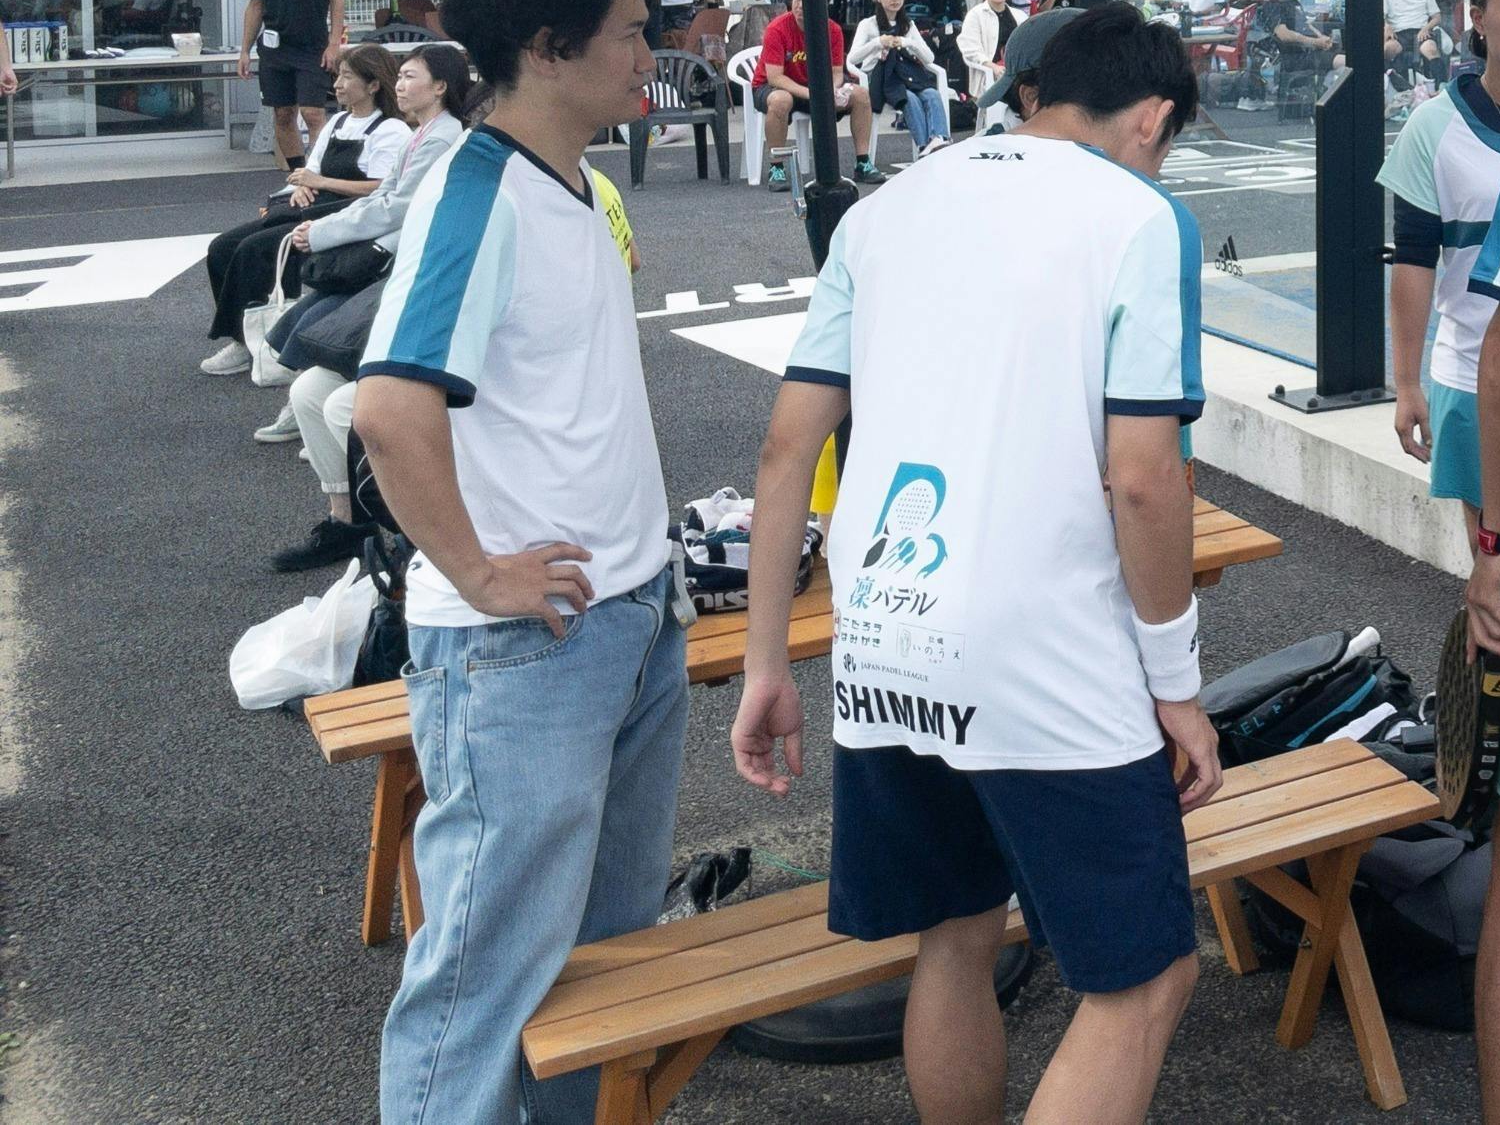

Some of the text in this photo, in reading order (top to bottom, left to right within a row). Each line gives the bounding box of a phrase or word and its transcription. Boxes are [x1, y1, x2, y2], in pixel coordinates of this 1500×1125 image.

[860, 661, 930, 683] JAPAN PADEL LEAGUE
[835, 680, 977, 746] SHIMMY
